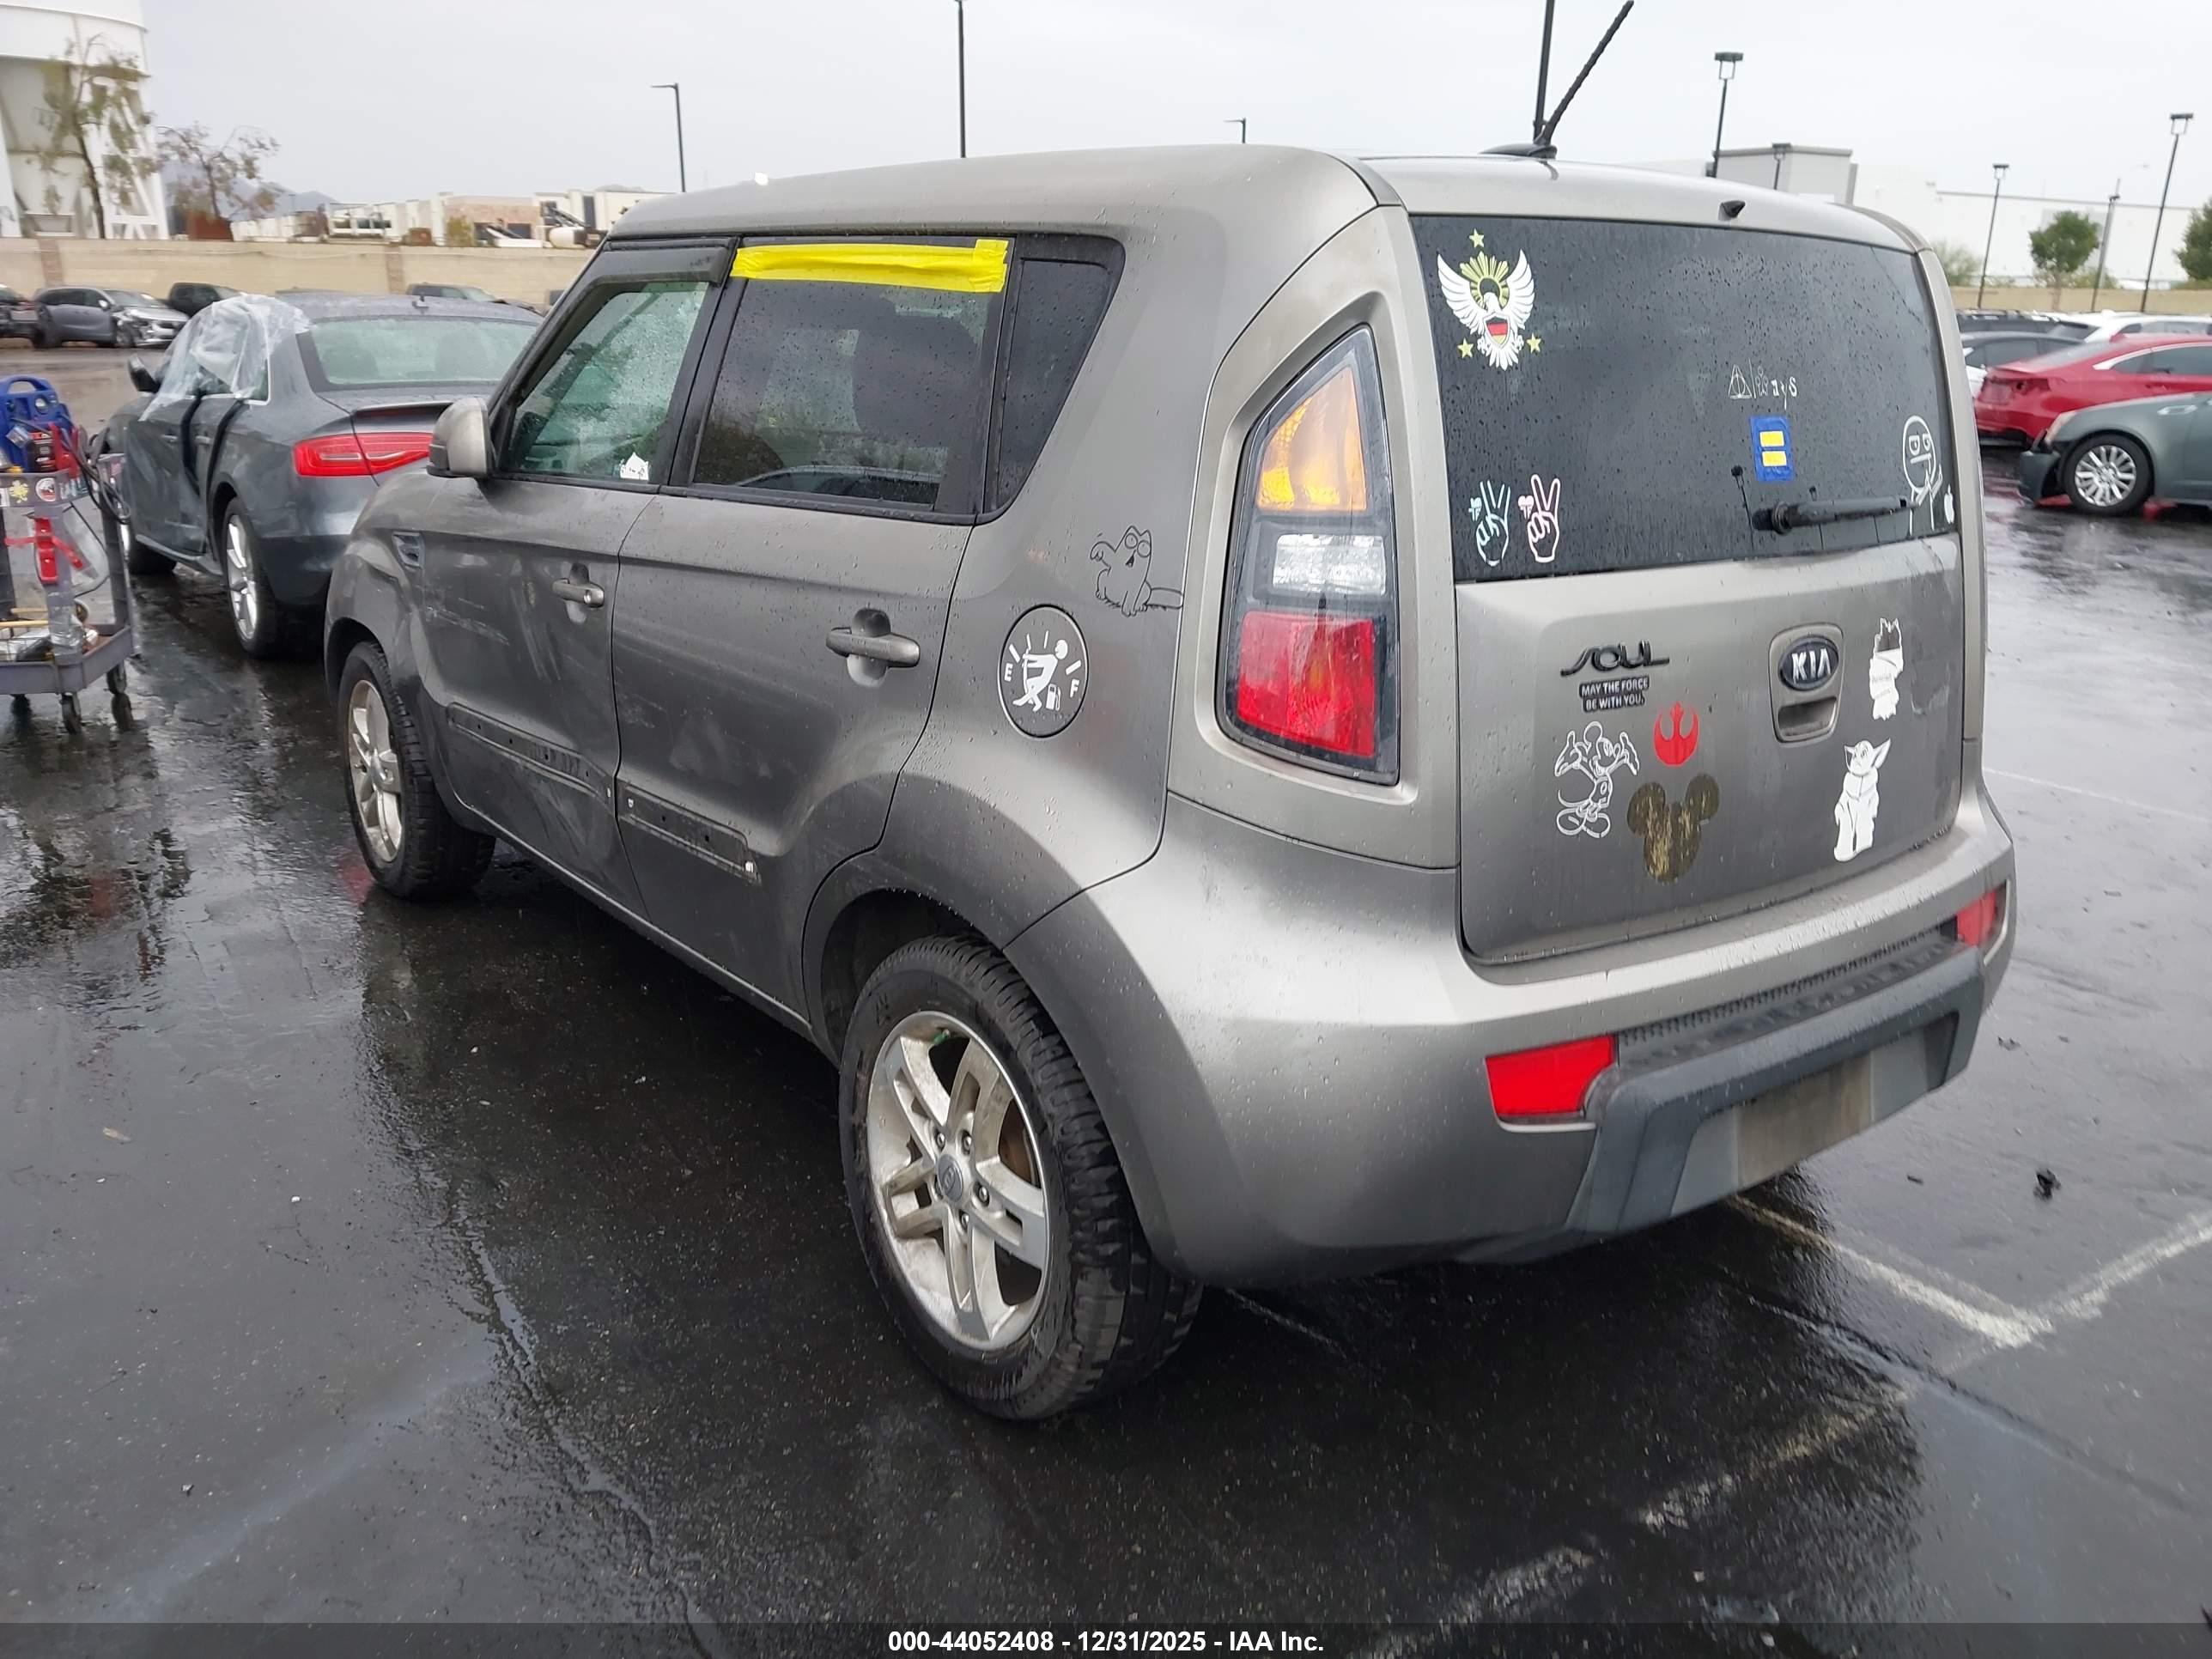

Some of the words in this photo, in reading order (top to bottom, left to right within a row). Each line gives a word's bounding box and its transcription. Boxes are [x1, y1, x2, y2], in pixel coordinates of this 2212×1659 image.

[1004, 662, 1013, 682] E
[1791, 647, 1832, 684] KIA
[1069, 678, 1080, 698] F
[1581, 683, 1601, 696] MAY
[1602, 680, 1620, 695] THE
[1621, 677, 1649, 691] FORCE
[1585, 697, 1598, 711] BE
[1599, 695, 1622, 709] WITH
